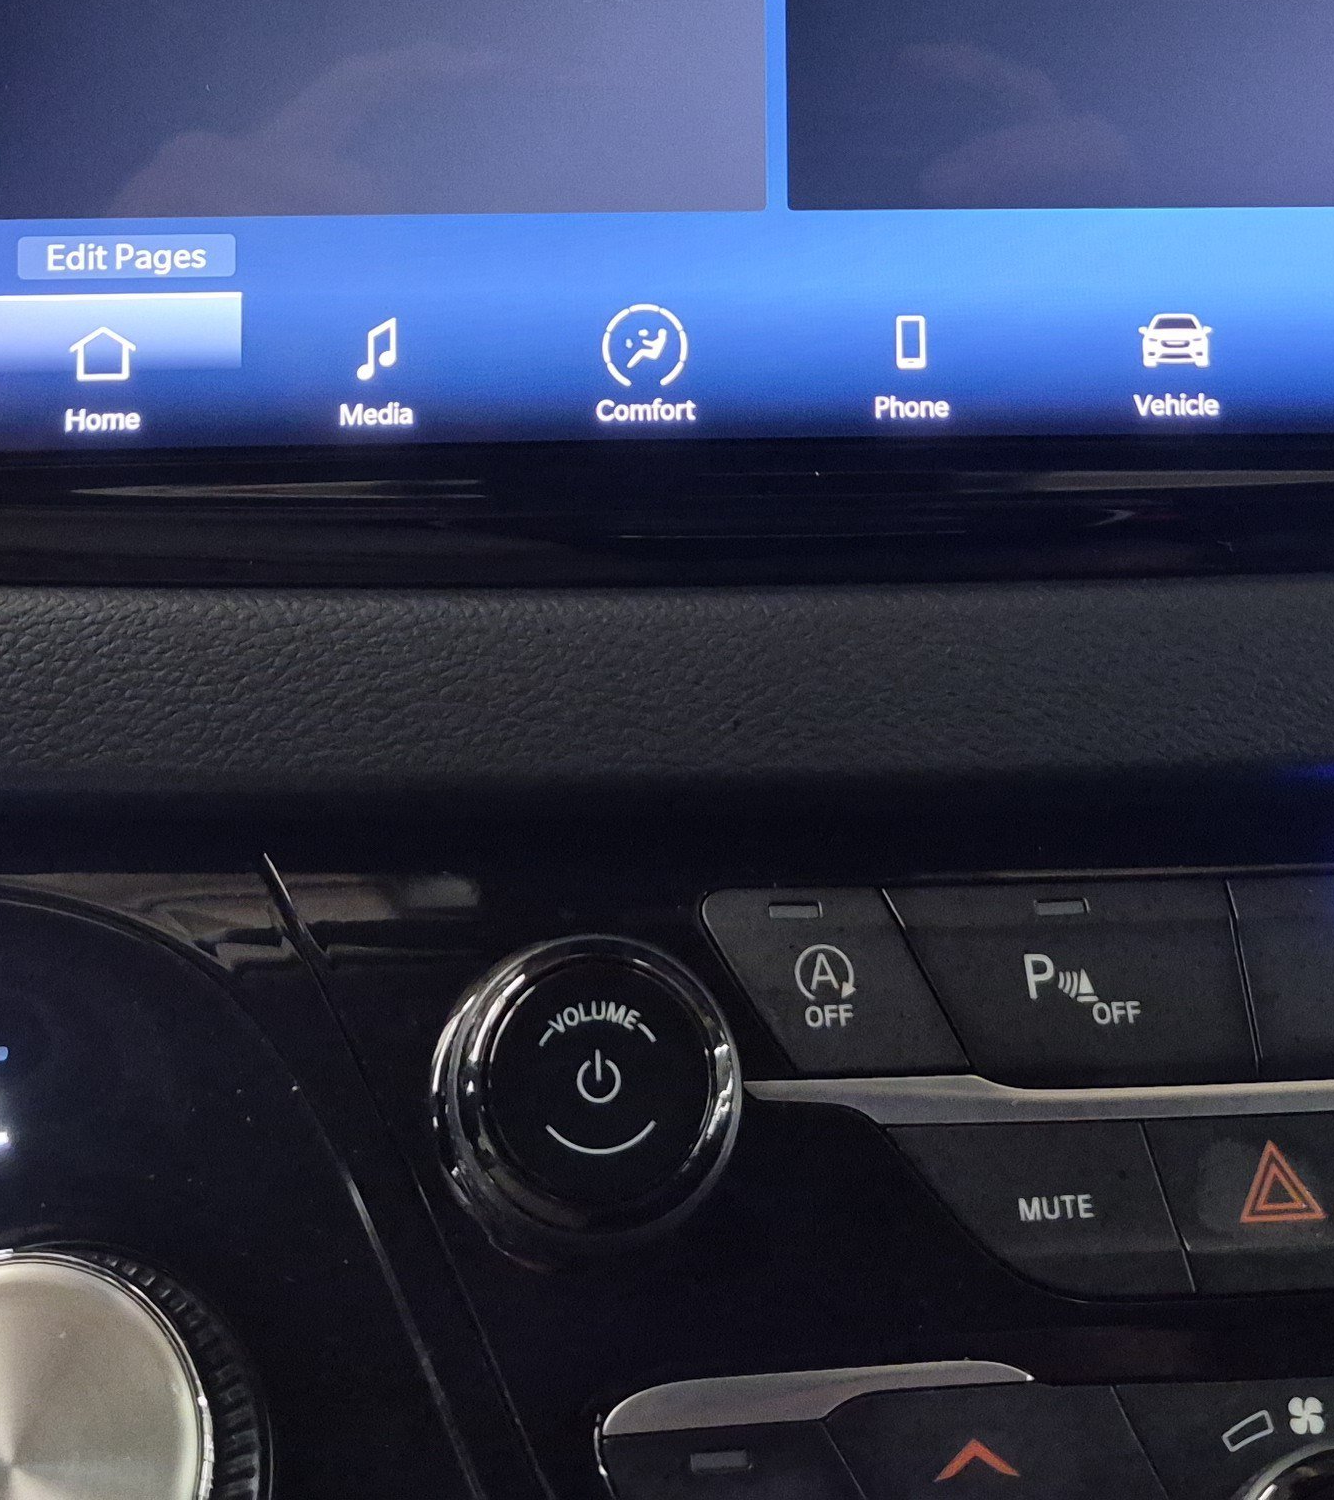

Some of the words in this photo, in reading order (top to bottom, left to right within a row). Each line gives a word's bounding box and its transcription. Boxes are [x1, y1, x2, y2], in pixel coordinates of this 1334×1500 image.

[47, 243, 108, 271] Edit
[115, 243, 207, 276] Pages
[339, 401, 414, 427] Media
[595, 397, 697, 422] Comfort
[874, 395, 950, 419] Phone
[1133, 392, 1220, 417] Vehicle
[64, 408, 141, 433] Home
[548, 1000, 641, 1033] VOLUME
[804, 1003, 854, 1028] OFF
[1092, 999, 1142, 1025] OFF
[1018, 1194, 1094, 1222] MUTE
